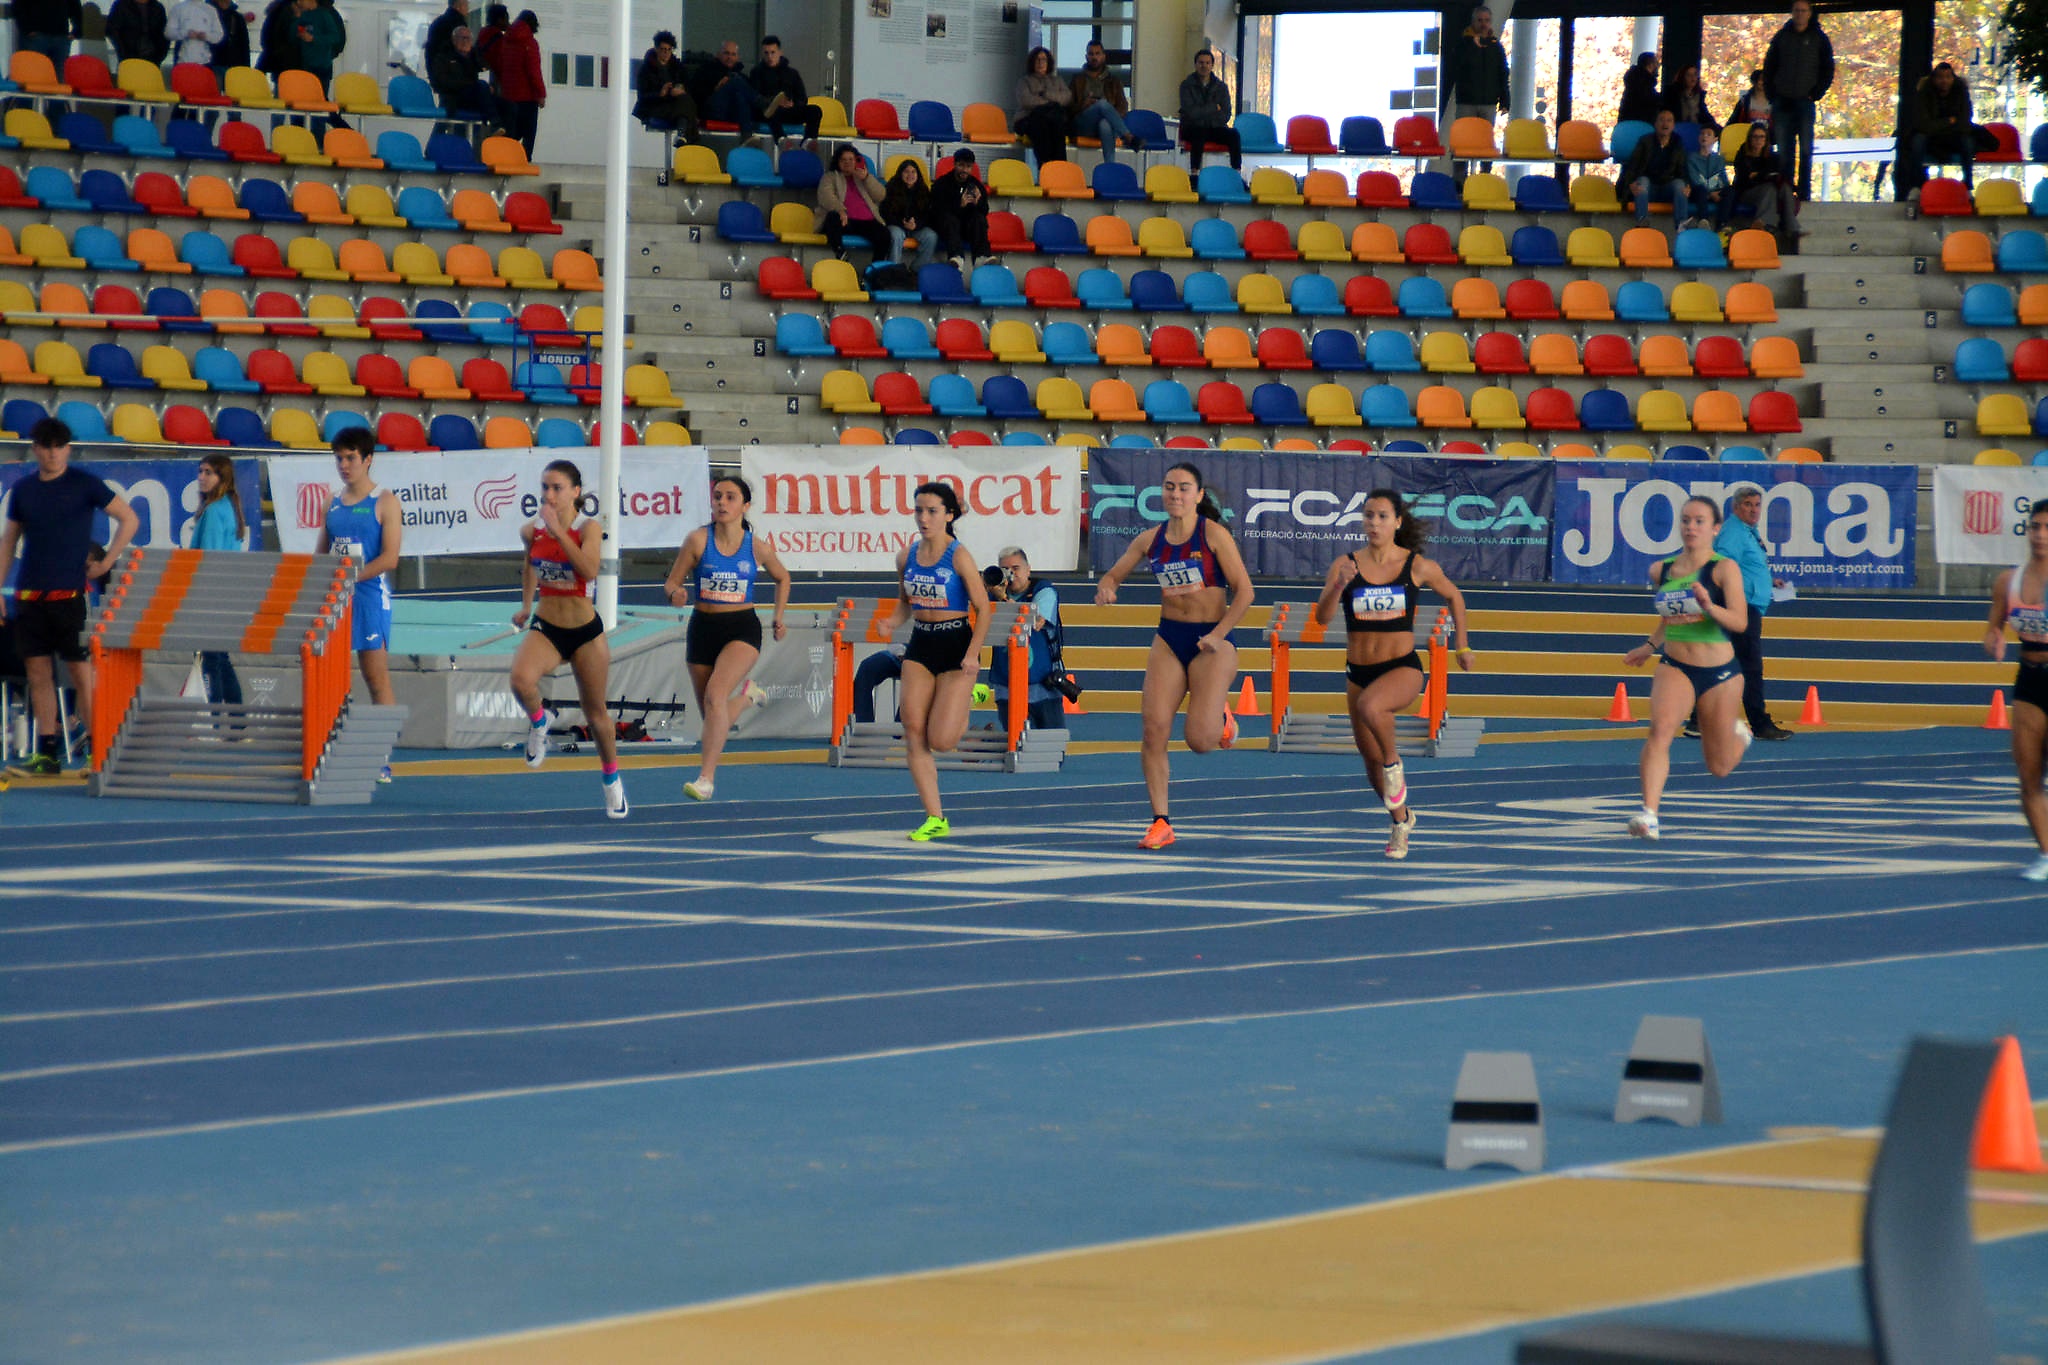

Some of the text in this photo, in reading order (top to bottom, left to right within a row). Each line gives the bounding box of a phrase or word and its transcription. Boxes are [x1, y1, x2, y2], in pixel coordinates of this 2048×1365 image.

[722, 286, 730, 297] 6
[756, 342, 763, 354] 5
[538, 353, 581, 365] MONDO
[789, 399, 797, 411] 4
[762, 465, 1063, 517] mutuacat
[1092, 484, 1236, 521] FC
[1562, 478, 1904, 567] Joma
[1244, 529, 1293, 540] FEDERACIÓ
[1295, 531, 1341, 541] CATALANA
[1499, 537, 1548, 546] ATLETISME
[1165, 570, 1193, 586] 131
[708, 580, 739, 593] 263
[910, 583, 938, 599] 264
[1362, 596, 1396, 612] 162
[1667, 600, 1688, 615] 52
[933, 620, 962, 631] PRO
